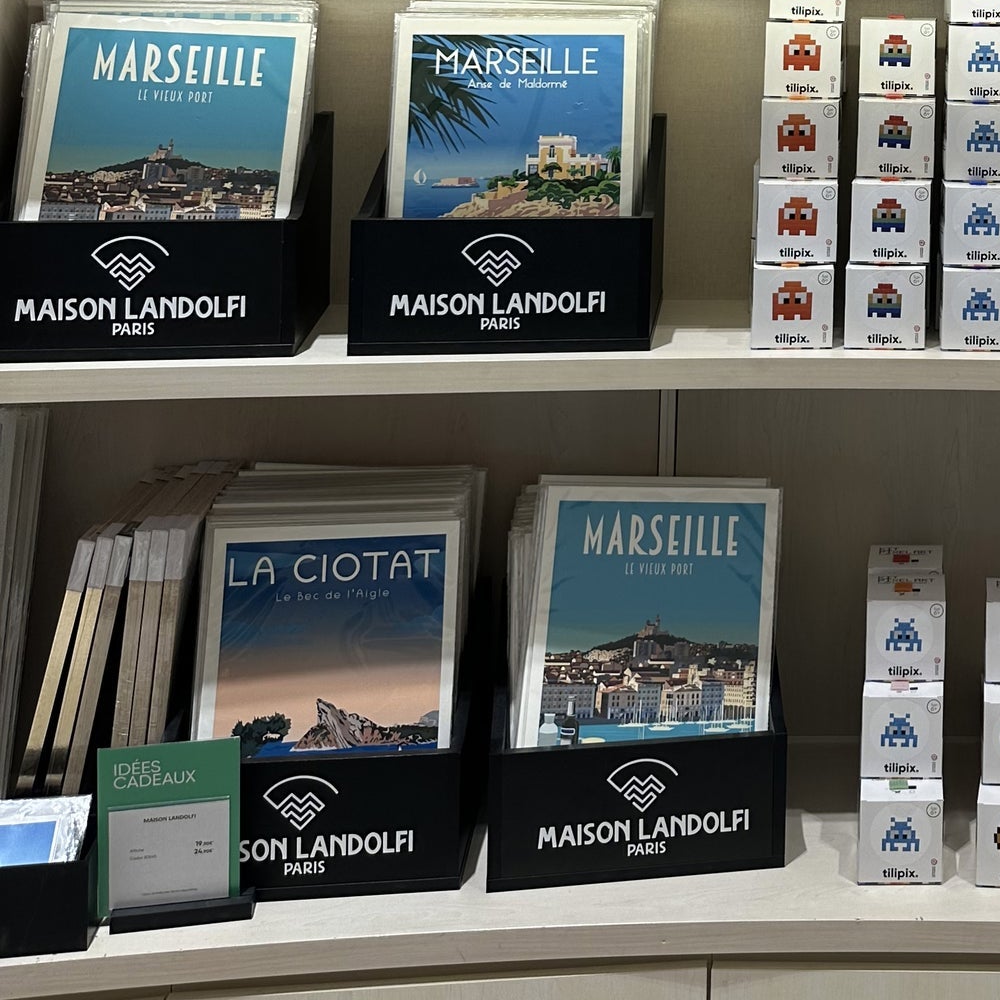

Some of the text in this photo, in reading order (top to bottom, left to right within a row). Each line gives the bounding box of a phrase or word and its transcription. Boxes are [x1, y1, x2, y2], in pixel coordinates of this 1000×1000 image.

[792, 6, 824, 17] tilipix.
[92, 38, 266, 86] MARSEILLE
[435, 47, 599, 75] MARSEILLE
[468, 79, 492, 89] Anse
[499, 78, 511, 89] de
[786, 83, 819, 94] tilipix.
[881, 81, 914, 92] tilipix.
[138, 89, 213, 104] LE VIEUX PORT
[782, 164, 816, 175] tilipix.
[879, 163, 912, 174] tilipix.
[968, 167, 1000, 178] tilipix.
[780, 248, 813, 259] tilipix.
[873, 248, 907, 259] tilipix.
[967, 251, 1000, 262] tilipix.
[14, 295, 246, 322] MAISON LANDOLFI
[389, 291, 606, 316] MAISON LANDOLFI
[112, 322, 155, 336] PARIS
[480, 317, 521, 330] PARIS
[775, 334, 809, 345] tilipix.
[867, 334, 902, 345] tilipix.
[964, 336, 999, 348] tilipix.
[583, 509, 740, 556] MARSEILLE
[228, 549, 440, 587] LA CIOTAT
[625, 562, 694, 576] LE VIEUX PORT
[275, 588, 390, 602] Le Bec de l'Aigle
[888, 666, 922, 678] tilipix.
[113, 759, 161, 776] IDÉES
[884, 763, 919, 774] tilipix.
[113, 770, 196, 790] CADEAUX
[537, 808, 750, 849] MAISON LANDOLFI
[239, 830, 414, 862] SON LANDOLFI
[627, 841, 666, 857] PARIS
[284, 860, 325, 875] PARIS
[883, 868, 918, 880] tilipix.
